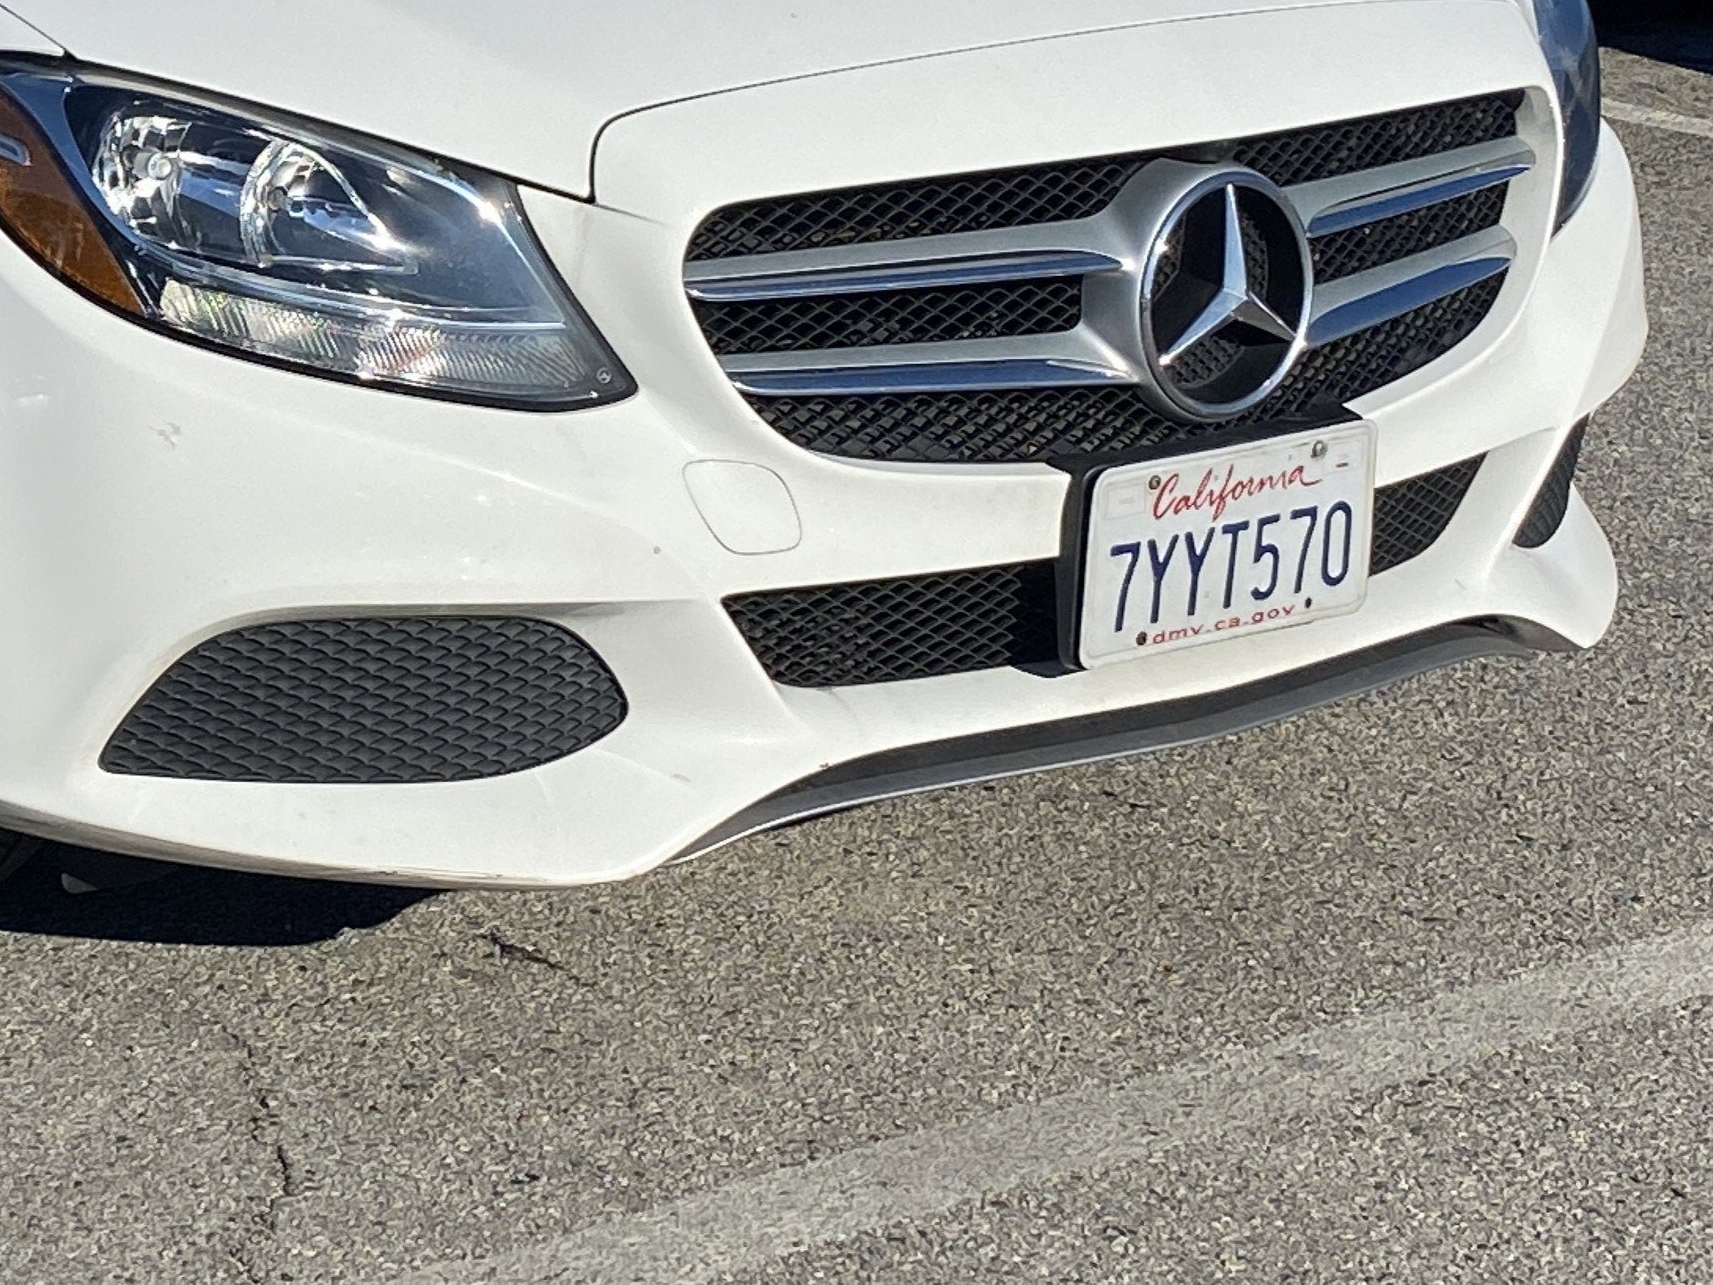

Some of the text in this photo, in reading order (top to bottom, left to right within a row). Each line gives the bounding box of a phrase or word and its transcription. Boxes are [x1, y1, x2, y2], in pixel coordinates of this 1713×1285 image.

[1153, 465, 1322, 521] California
[1110, 500, 1353, 633] 7YYT570
[1152, 604, 1296, 645] dmv.ca.gov
